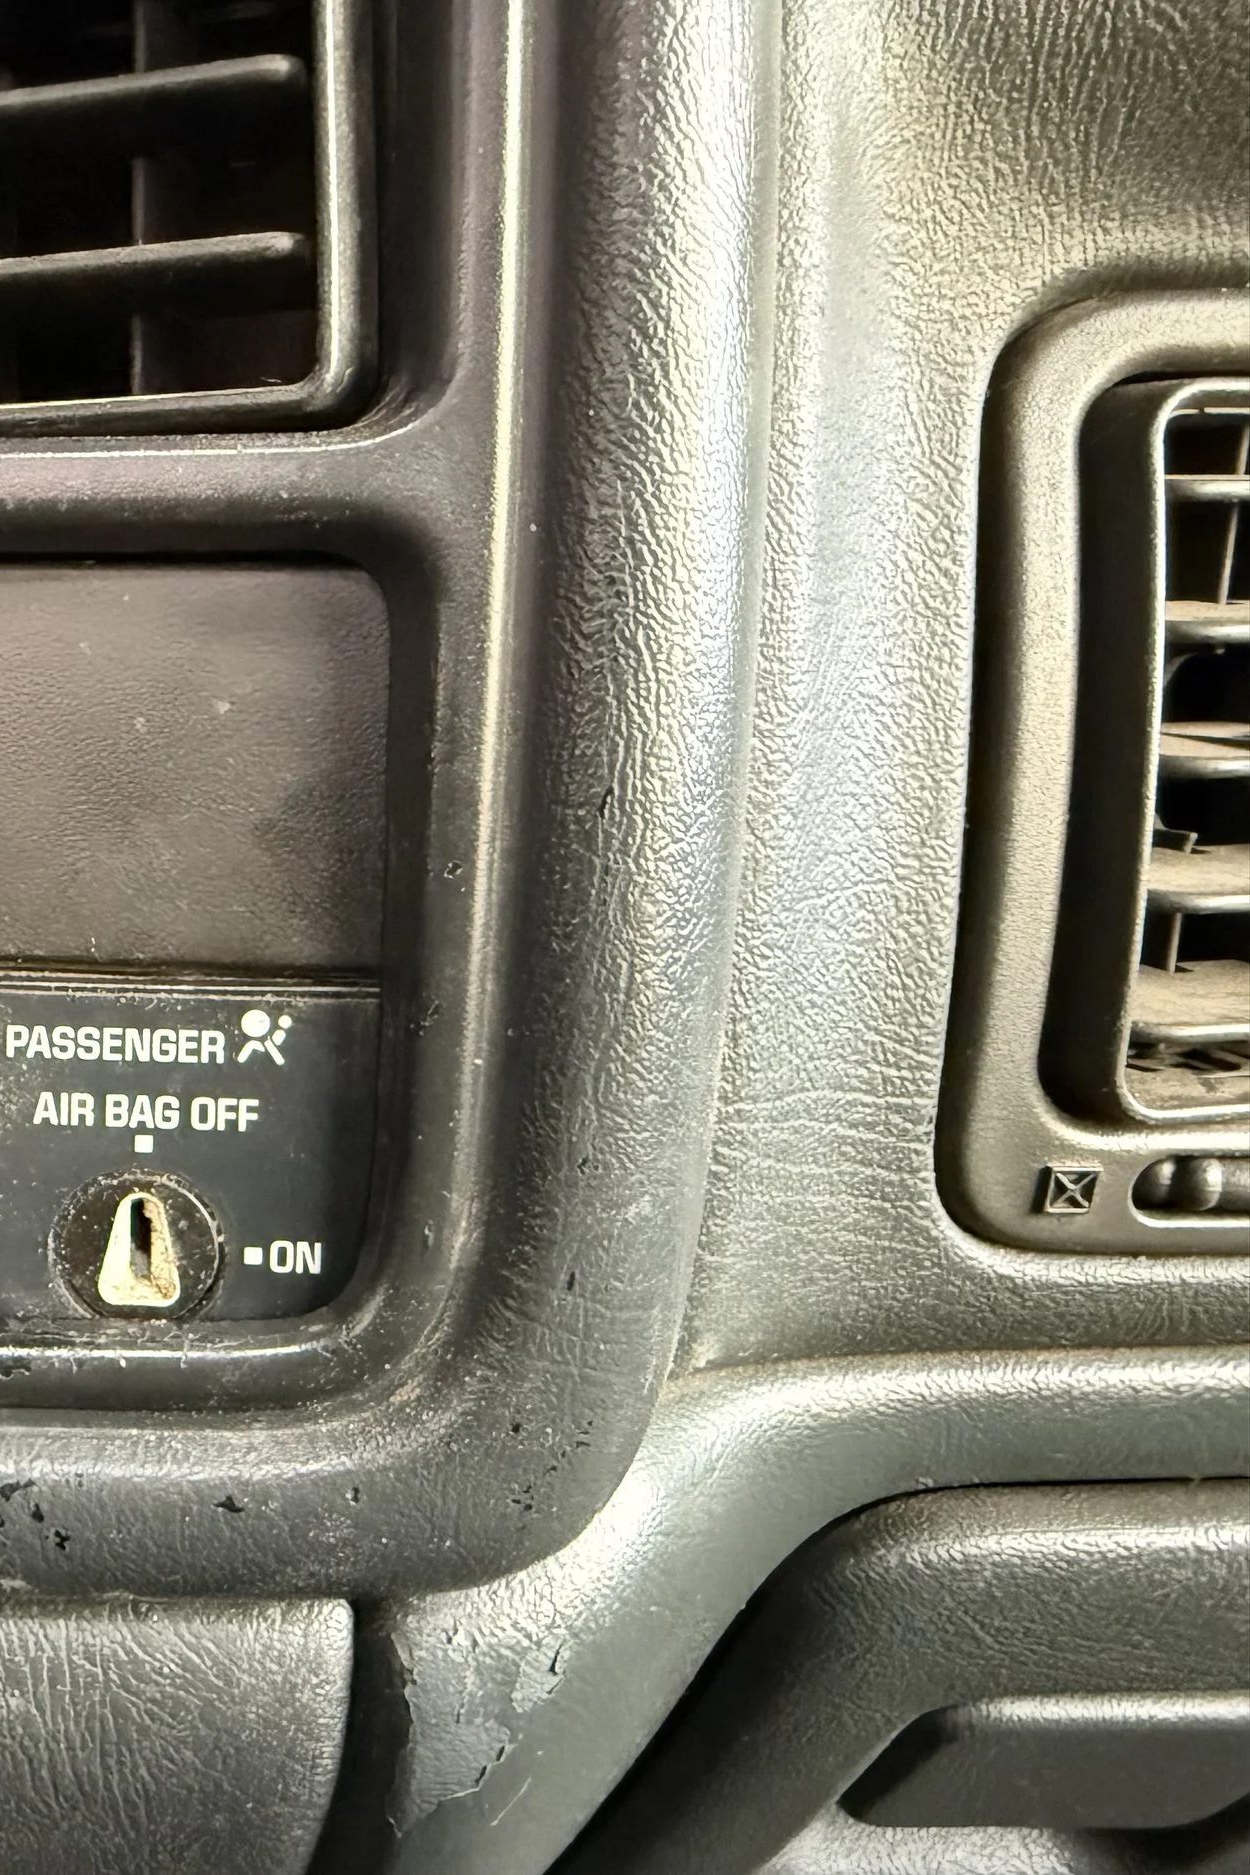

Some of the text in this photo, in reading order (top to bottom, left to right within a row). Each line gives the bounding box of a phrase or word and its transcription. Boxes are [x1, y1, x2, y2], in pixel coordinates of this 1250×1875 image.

[5, 1024, 226, 1065] PASSENGER
[32, 1090, 260, 1132] AIR BAG OFF
[269, 1240, 322, 1275] ON
